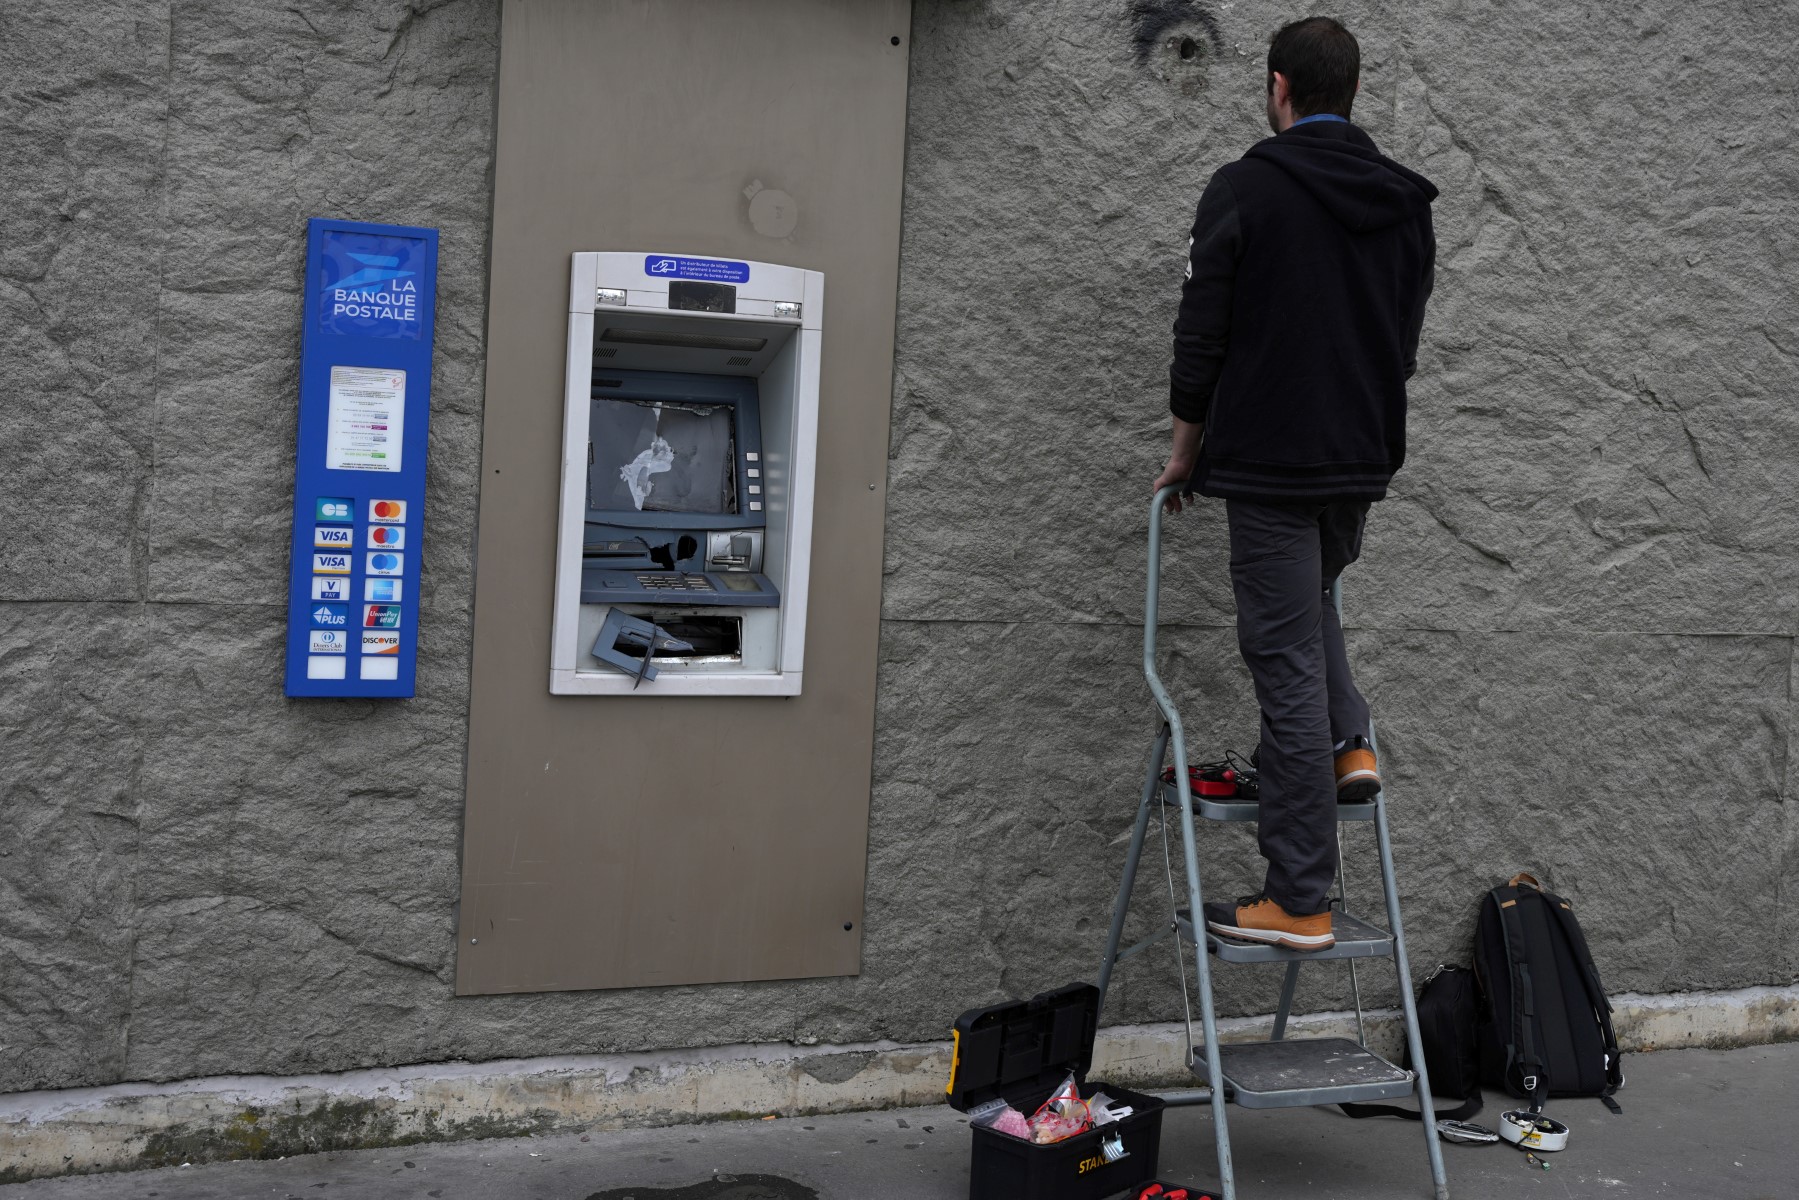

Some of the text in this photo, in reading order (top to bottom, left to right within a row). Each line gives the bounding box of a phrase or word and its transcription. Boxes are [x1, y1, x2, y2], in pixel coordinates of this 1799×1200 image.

[392, 279, 416, 292] LA
[334, 288, 416, 307] BANQUE
[334, 304, 416, 320] POSTALE
[322, 504, 348, 516] CB
[320, 531, 348, 541] VISA
[318, 556, 346, 566] VISA
[326, 581, 336, 590] V
[321, 616, 346, 624] PLUS
[370, 610, 398, 620] UnionPay
